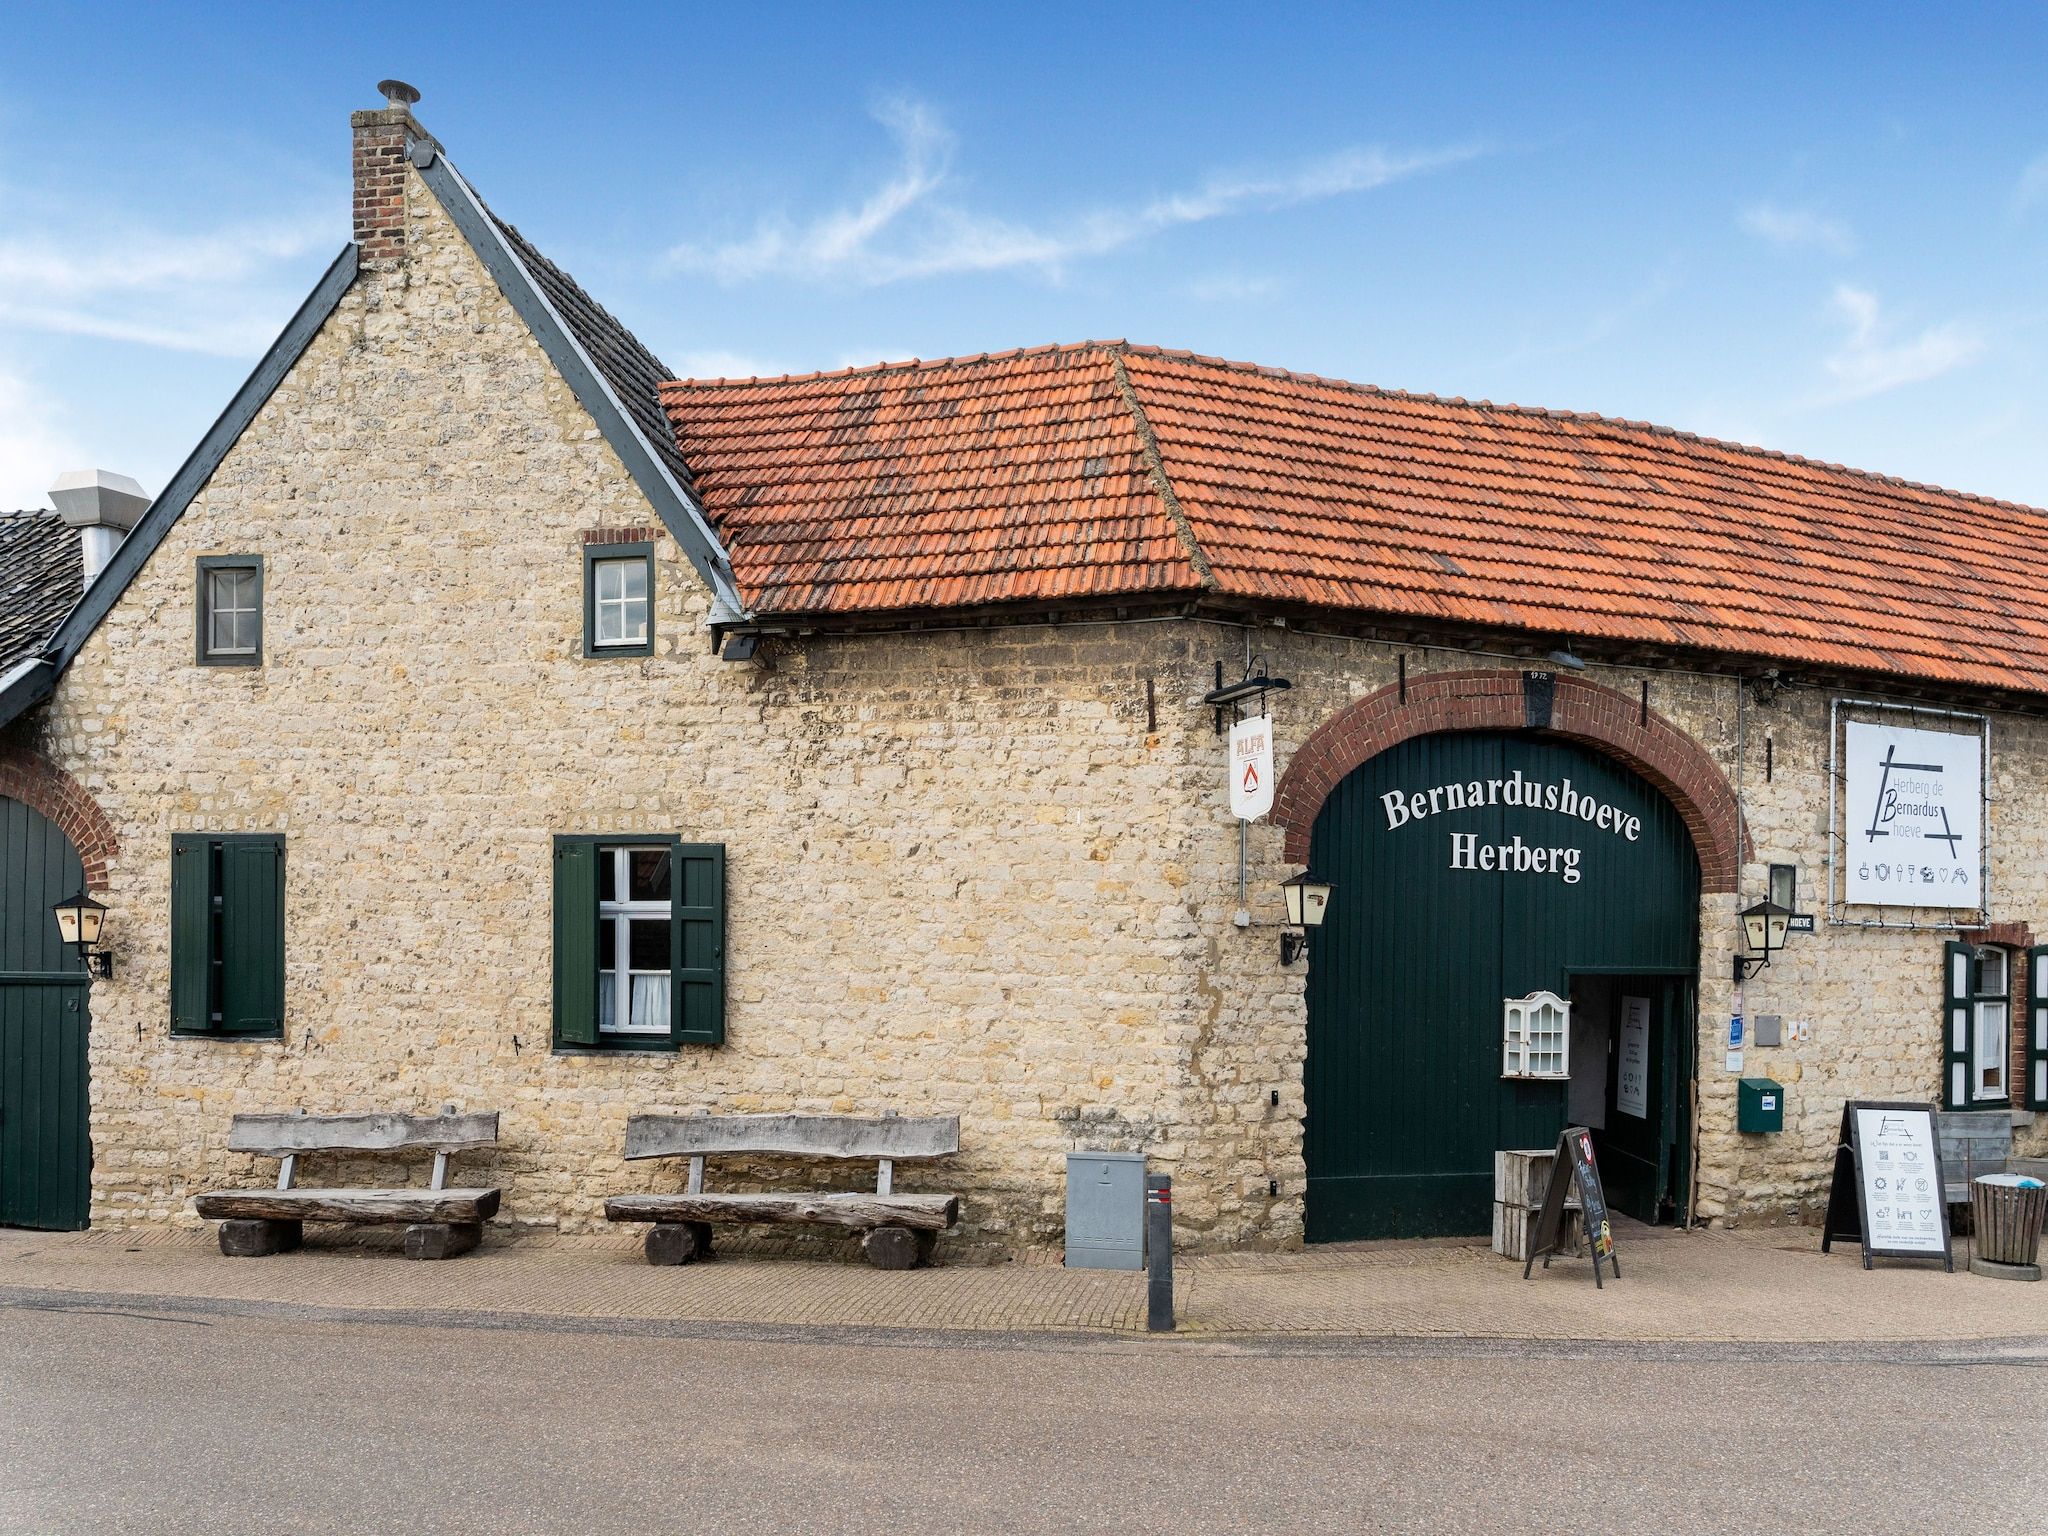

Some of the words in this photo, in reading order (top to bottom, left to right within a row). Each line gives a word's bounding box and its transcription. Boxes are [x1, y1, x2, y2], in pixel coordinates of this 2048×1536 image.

[1236, 733, 1265, 757] ALFA
[1893, 777, 1930, 799] Herberg
[1932, 782, 1944, 796] de
[1379, 770, 1641, 842] Bernardushoeve
[1881, 788, 1939, 822] Bernardus
[1893, 822, 1921, 839] hoeve
[1449, 832, 1582, 884] Herberg
[1790, 917, 1811, 928] HOEVE
